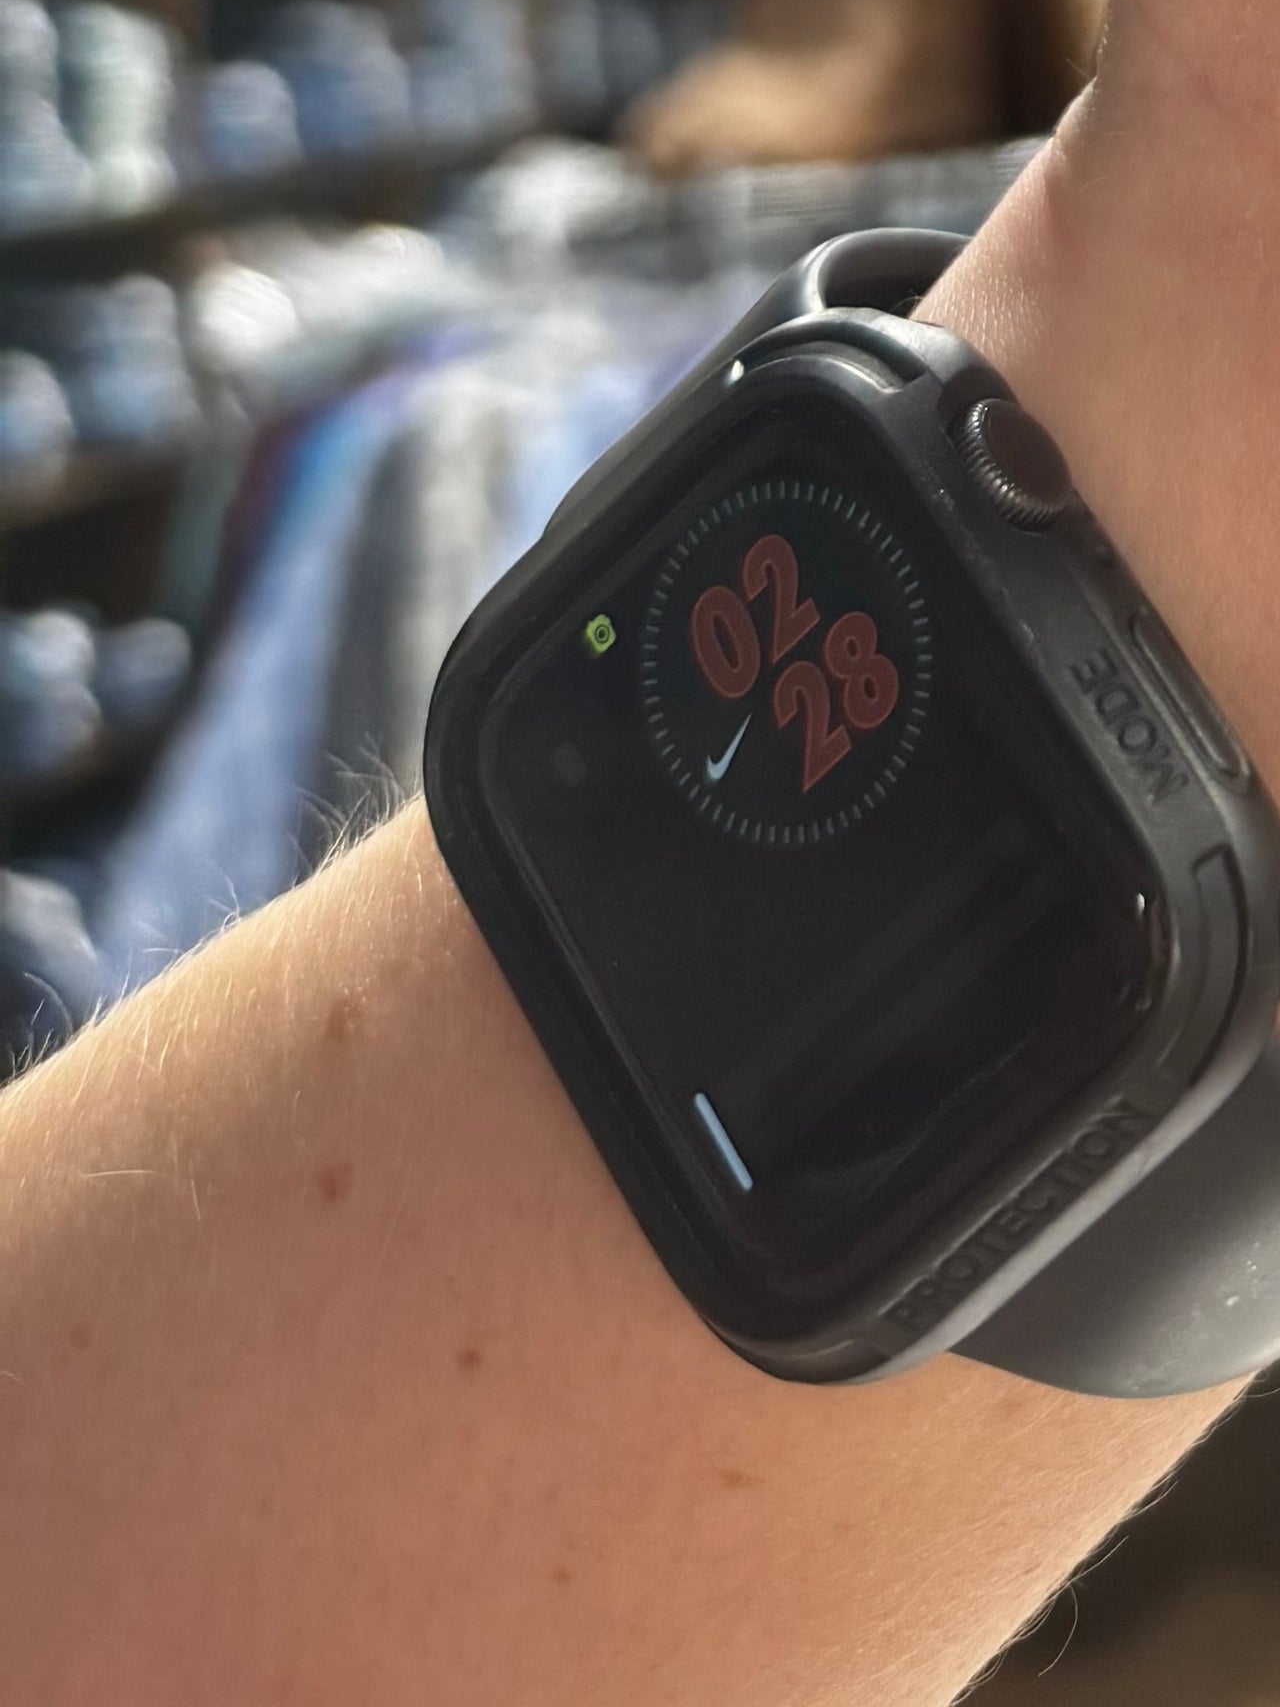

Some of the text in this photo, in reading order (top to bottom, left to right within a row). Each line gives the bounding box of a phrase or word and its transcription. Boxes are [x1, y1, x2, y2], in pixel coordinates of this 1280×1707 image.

[691, 533, 821, 699] 02
[773, 611, 899, 794] 28
[1067, 647, 1189, 804] MODE
[884, 1099, 1155, 1333] PROTECTION
